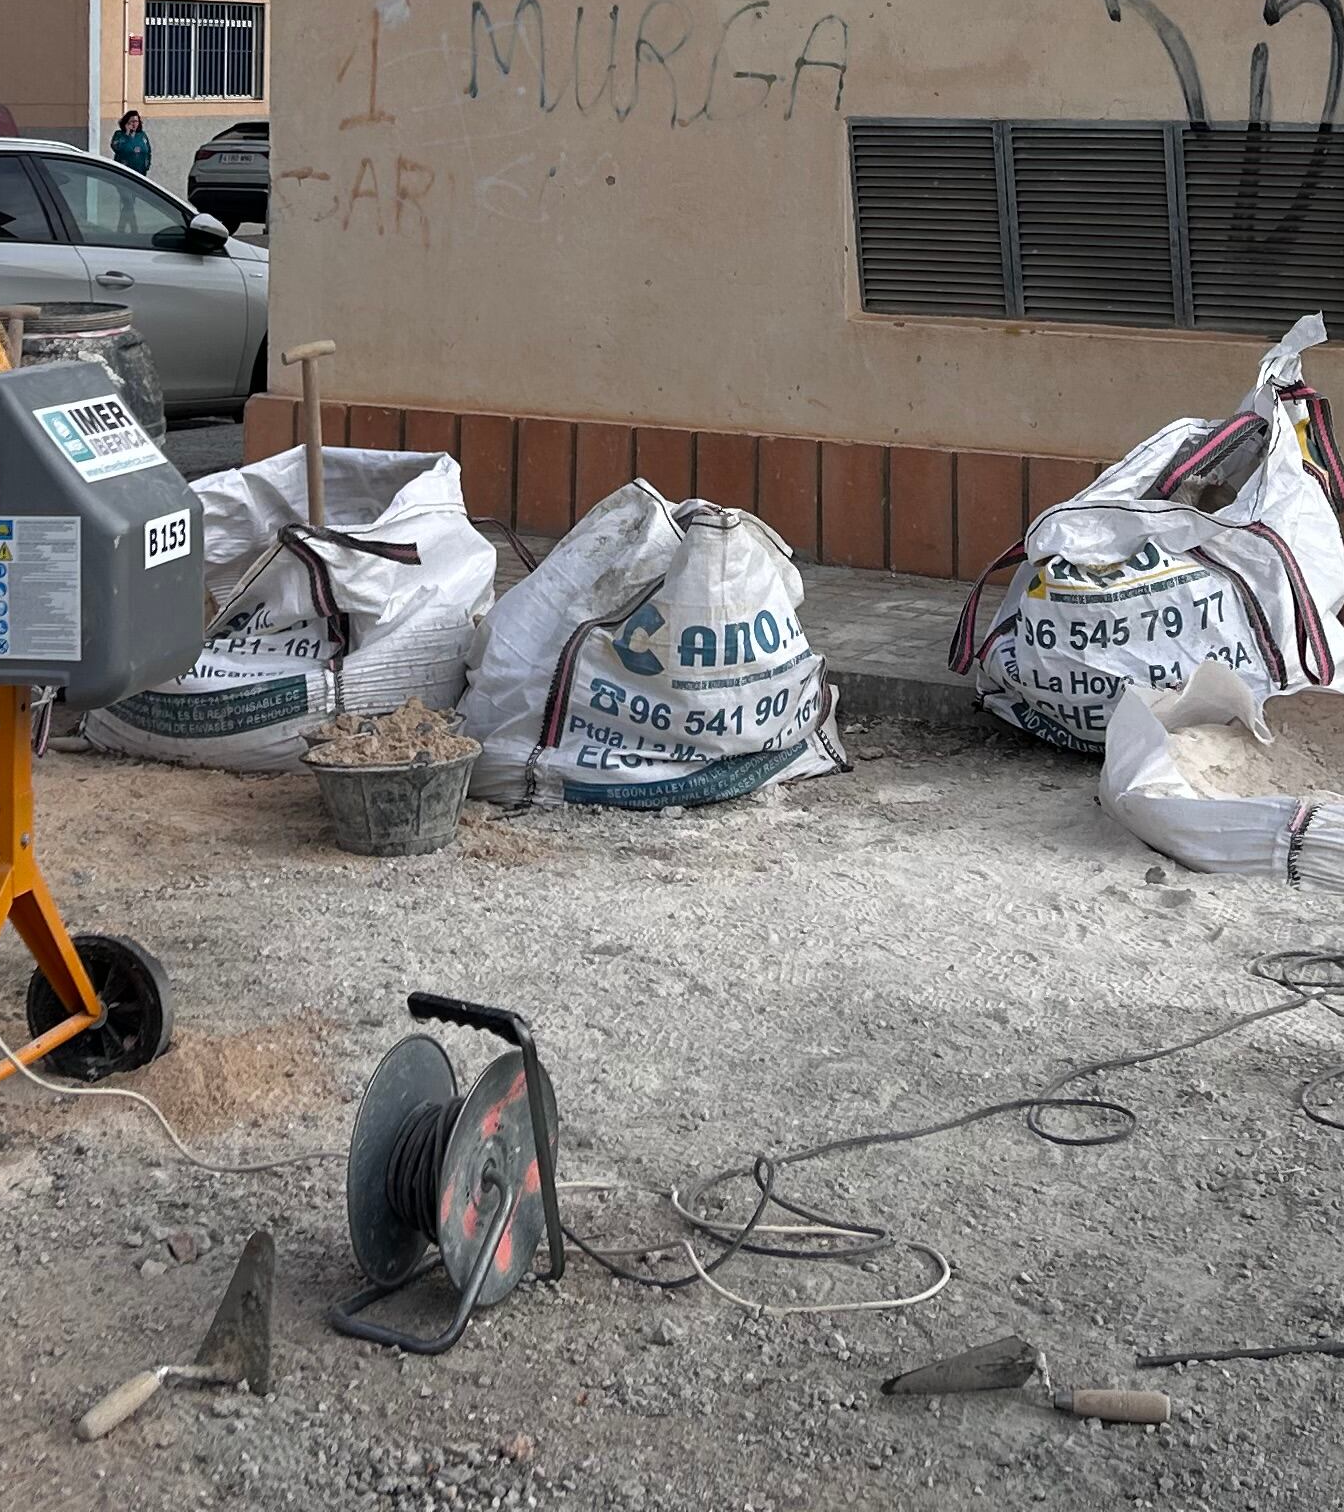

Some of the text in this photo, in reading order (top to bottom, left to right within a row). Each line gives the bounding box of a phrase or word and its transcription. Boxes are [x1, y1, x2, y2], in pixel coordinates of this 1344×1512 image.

[68, 401, 134, 436] IMER
[1069, 617, 1130, 651] 545
[1141, 607, 1183, 641] 79
[1193, 591, 1224, 630] 77
[284, 638, 321, 659] 161
[1033, 670, 1062, 693] La
[629, 688, 789, 736] 96 541 90
[570, 715, 626, 750] Ptda.
[665, 782, 685, 794] LEY
